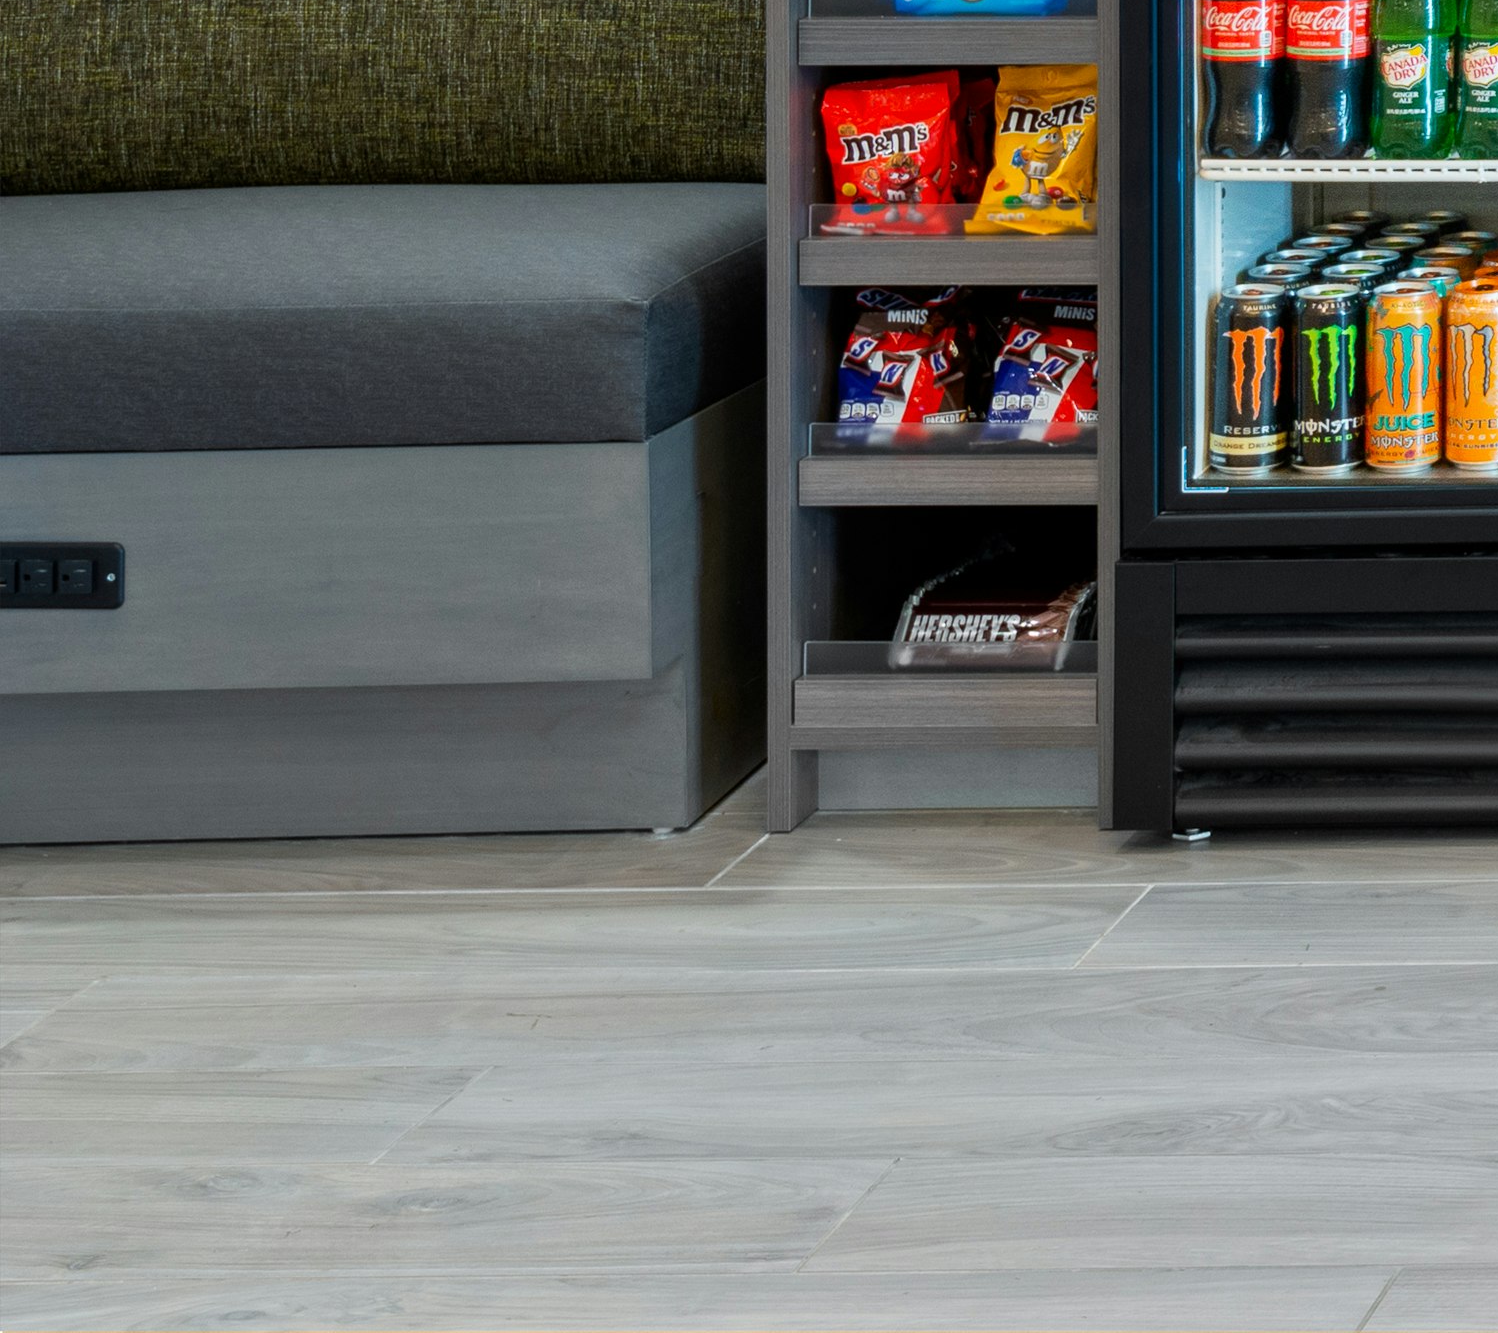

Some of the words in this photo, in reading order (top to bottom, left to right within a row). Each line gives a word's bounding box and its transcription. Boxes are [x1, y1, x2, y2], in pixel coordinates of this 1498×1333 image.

[1381, 53, 1428, 75] CANADA
[1394, 65, 1418, 80] DRY
[1373, 413, 1434, 431] JUICE
[909, 614, 1022, 643] HERSHEY'S
